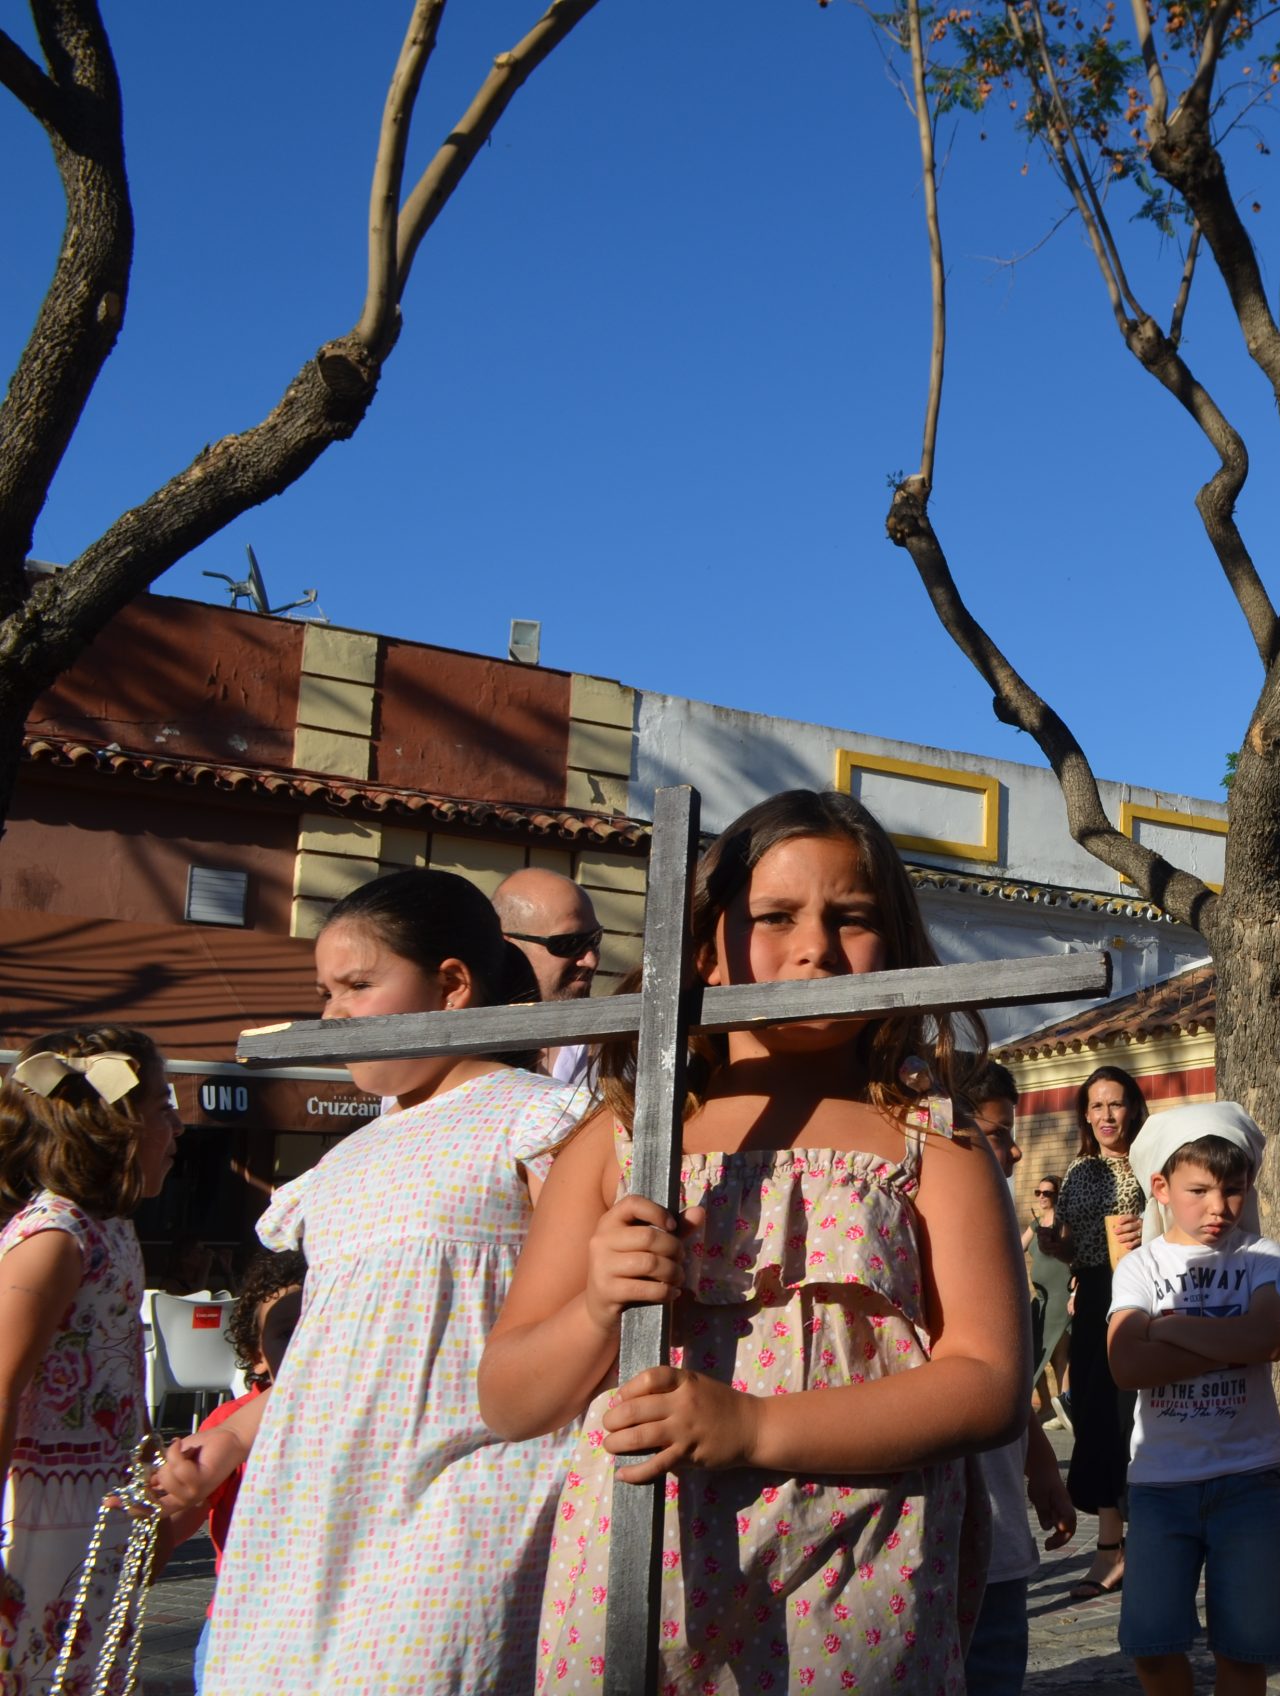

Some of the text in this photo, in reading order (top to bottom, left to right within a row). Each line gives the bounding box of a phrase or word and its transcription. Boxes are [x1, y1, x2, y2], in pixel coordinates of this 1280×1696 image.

[202, 1084, 249, 1112] UNO
[1154, 1267, 1246, 1301] GATEWAY
[1171, 1383, 1195, 1399] THE
[1201, 1378, 1246, 1398] SOUTH
[1150, 1399, 1189, 1409] NAUTICAL
[1156, 1406, 1237, 1423] Along The Way
